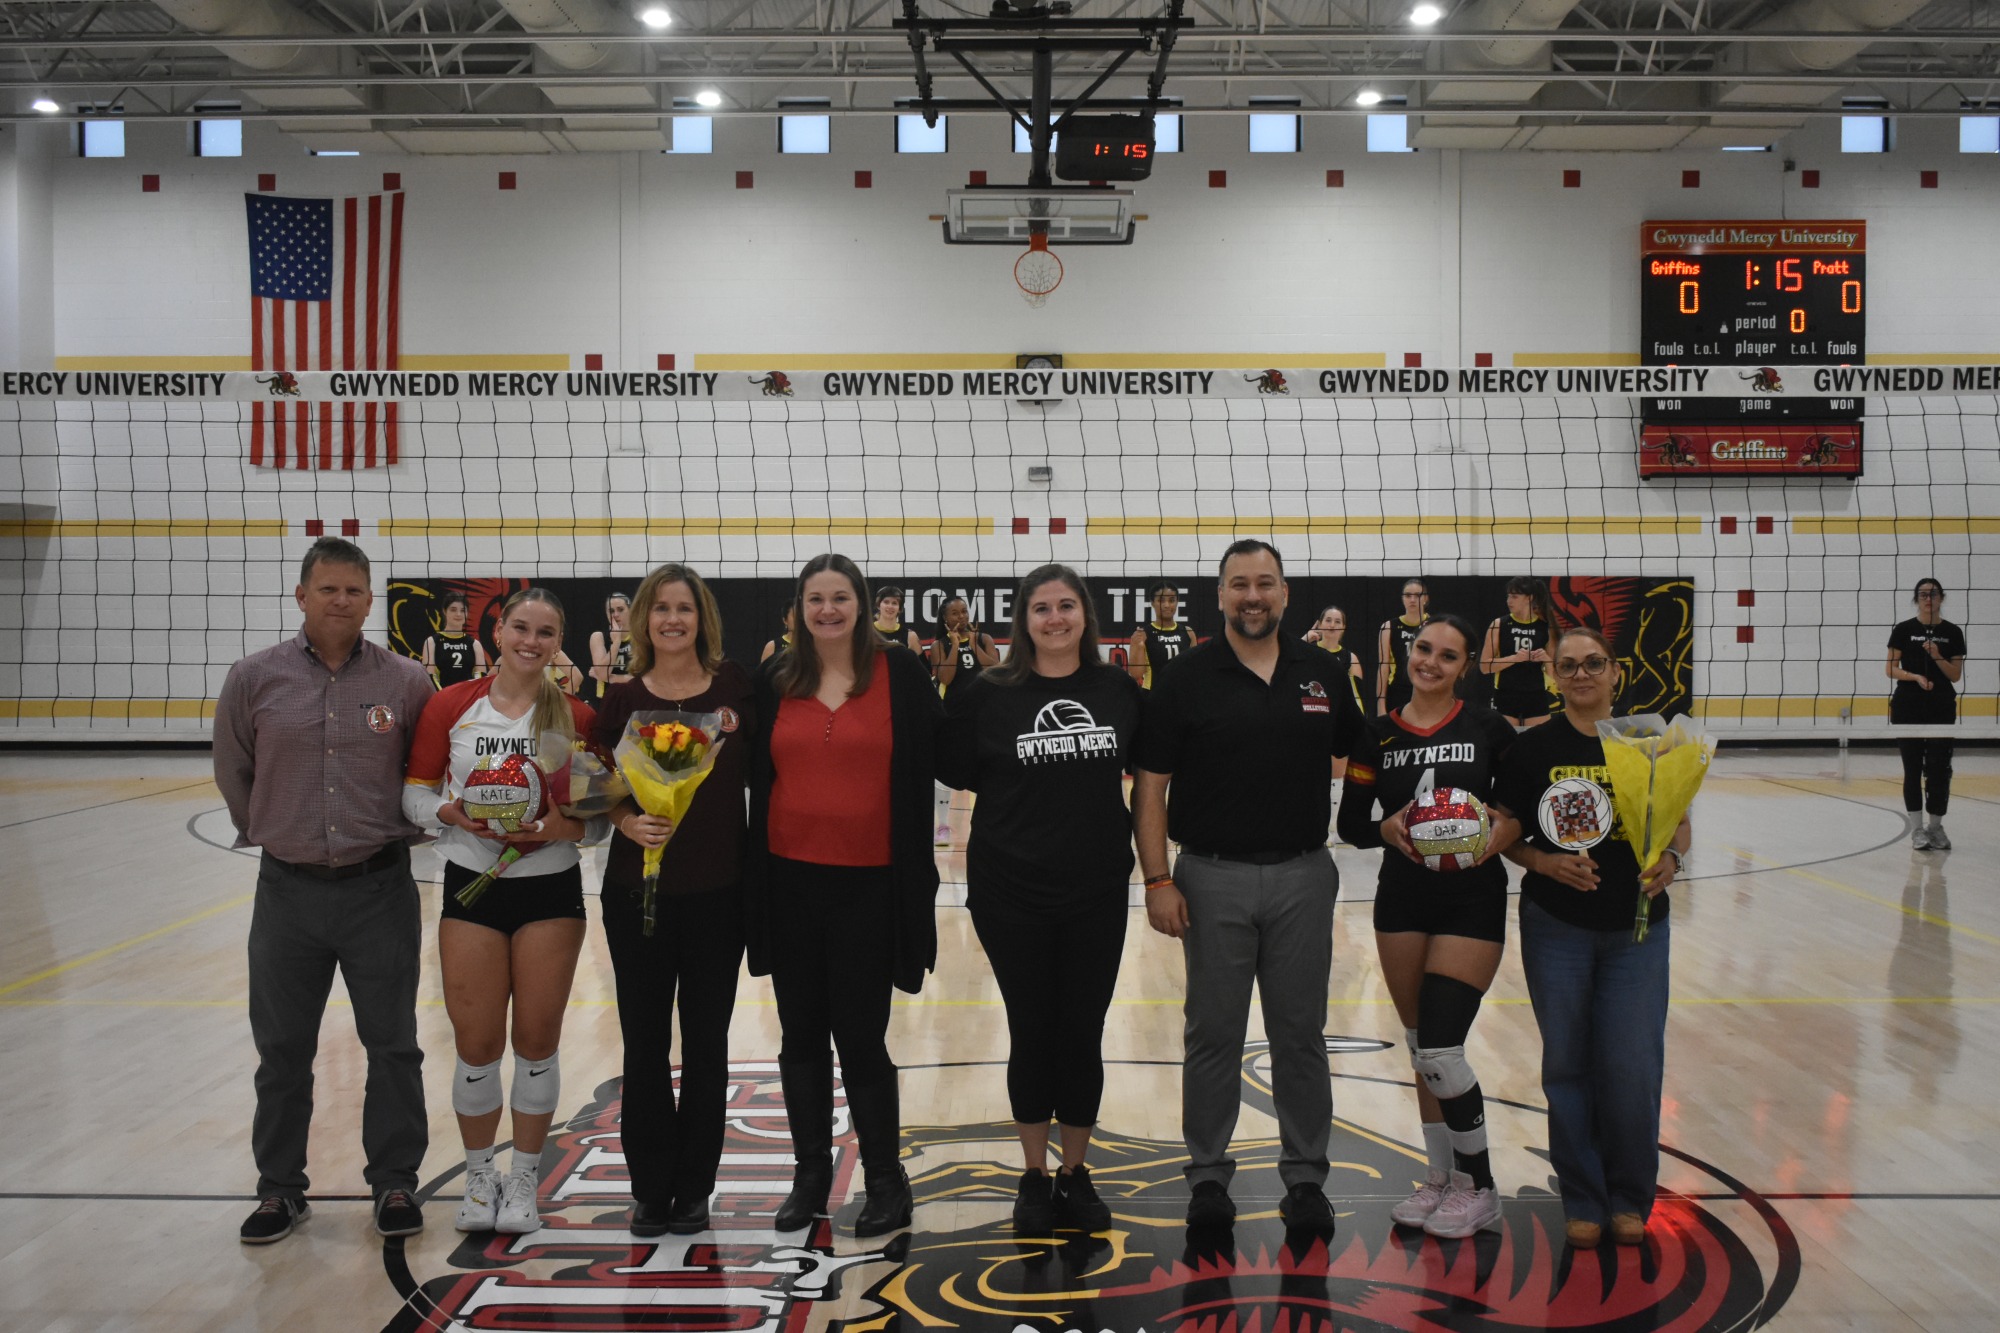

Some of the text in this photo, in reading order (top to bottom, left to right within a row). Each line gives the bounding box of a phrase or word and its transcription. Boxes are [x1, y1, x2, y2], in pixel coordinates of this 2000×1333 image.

[1653, 228, 1858, 247] Gwynedd Mercy University
[1651, 260, 1700, 275] Griffins
[1812, 259, 1850, 275] Pratt
[1679, 281, 1699, 314] 0
[1841, 280, 1861, 313] 0
[1735, 315, 1777, 332] period
[1790, 309, 1805, 333] 0
[1654, 341, 1684, 356] fouls
[1735, 340, 1777, 357] player
[1827, 341, 1857, 355] fouls
[3, 372, 226, 396] ERCY UNIVERSITY
[330, 372, 719, 396] GWYNEDD MERCY UNIVERSITY
[823, 371, 1214, 396] GWYNEDD MERCY UNIVERSITY
[1319, 368, 1709, 393] GWYNEDD MERCY UNIVERSITY
[1814, 368, 1944, 392] GWYNEDD
[1657, 399, 1682, 411] won
[1740, 399, 1771, 413] game
[1712, 439, 1789, 461] Griffins
[1511, 627, 1536, 636] Pratt
[1513, 636, 1533, 653] 19
[451, 652, 463, 668] 2
[962, 653, 974, 669] 9
[1017, 733, 1118, 759] GWYNEDD MERCY
[1022, 748, 1117, 766] VOLLEYBALL
[1382, 743, 1475, 770] GWYNEDD
[480, 788, 513, 801] KATE
[1434, 825, 1458, 837] DAR
